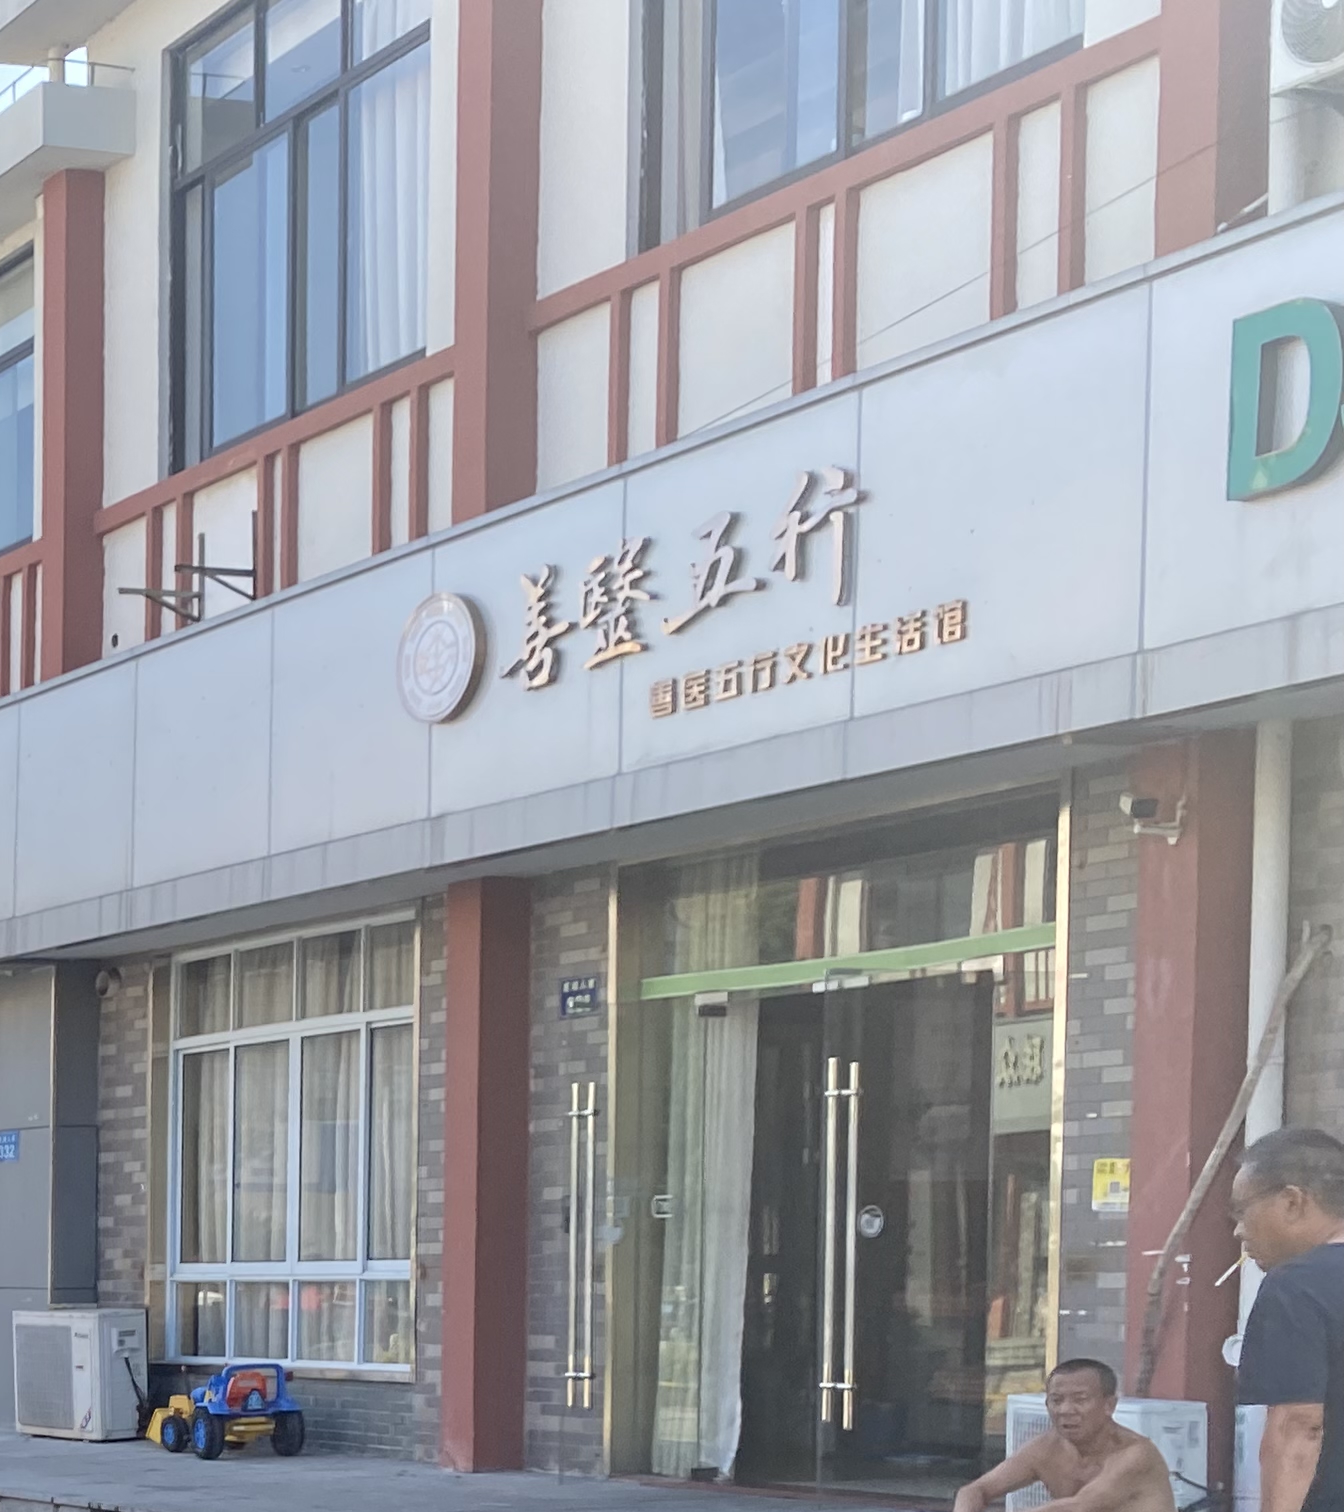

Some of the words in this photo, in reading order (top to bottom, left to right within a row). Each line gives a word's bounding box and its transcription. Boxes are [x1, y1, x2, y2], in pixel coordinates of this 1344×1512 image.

[650, 598, 968, 720] 善医五行文化生活馆
